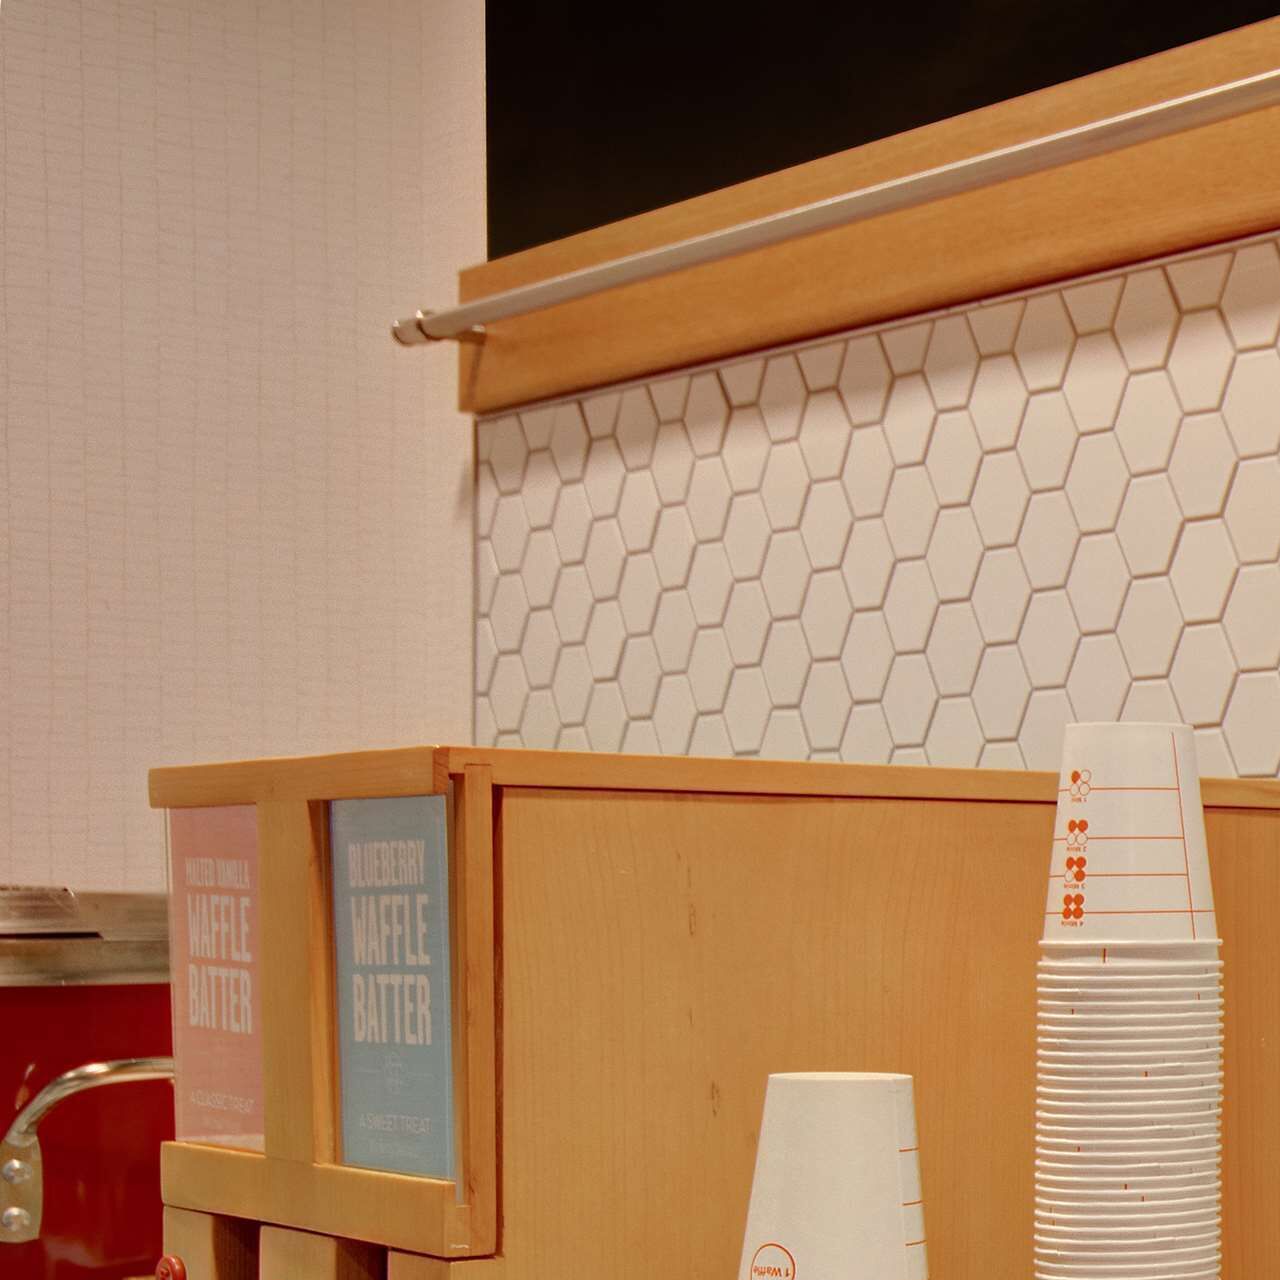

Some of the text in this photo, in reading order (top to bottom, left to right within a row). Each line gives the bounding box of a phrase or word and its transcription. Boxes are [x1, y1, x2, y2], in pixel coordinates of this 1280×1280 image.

[349, 839, 425, 888] BLUEBERRY
[187, 894, 252, 963] WAFFLE
[351, 894, 431, 966] WAFFLE
[188, 963, 252, 1035] BATTER
[352, 972, 432, 1046] BATTER
[399, 1115, 432, 1136] TREAT
[753, 1265, 782, 1278] Waffle
